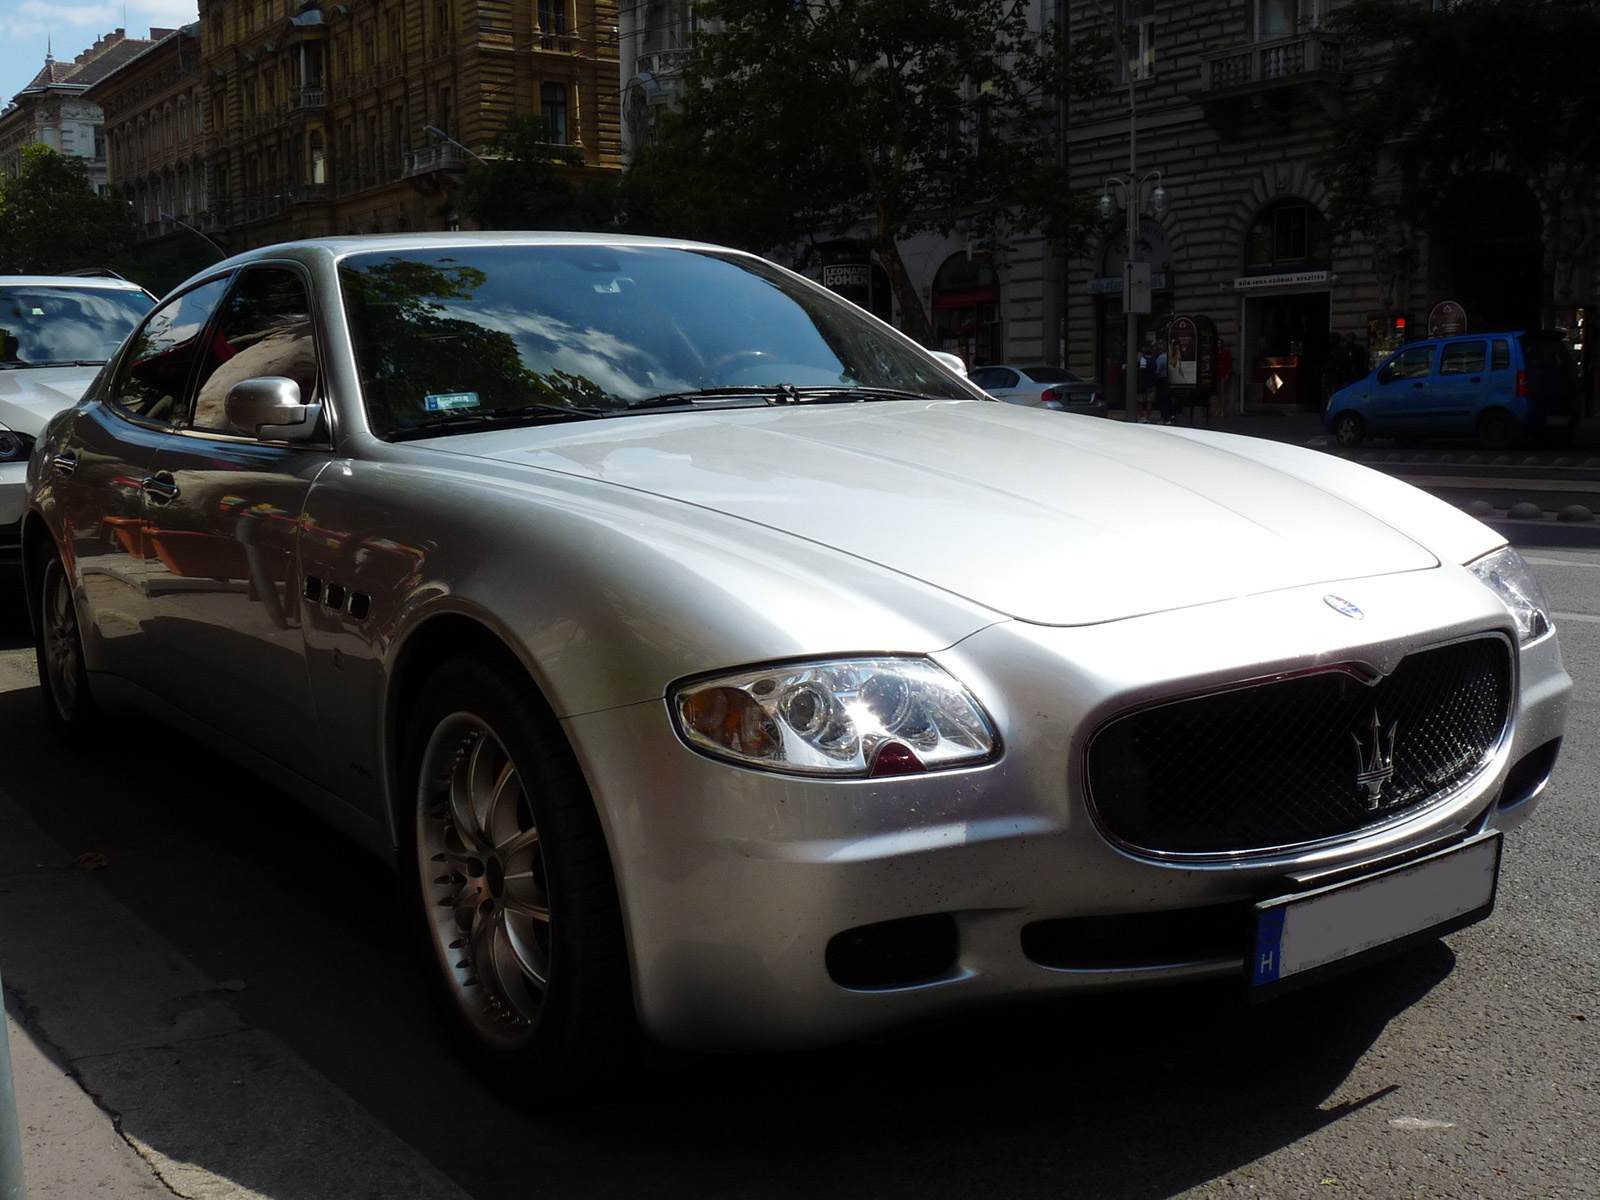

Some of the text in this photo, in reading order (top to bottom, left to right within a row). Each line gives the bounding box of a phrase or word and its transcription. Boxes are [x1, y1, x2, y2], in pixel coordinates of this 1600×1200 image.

[826, 267, 868, 276] LEONARD
[826, 275, 868, 287] COHEN
[1259, 950, 1274, 975] H
